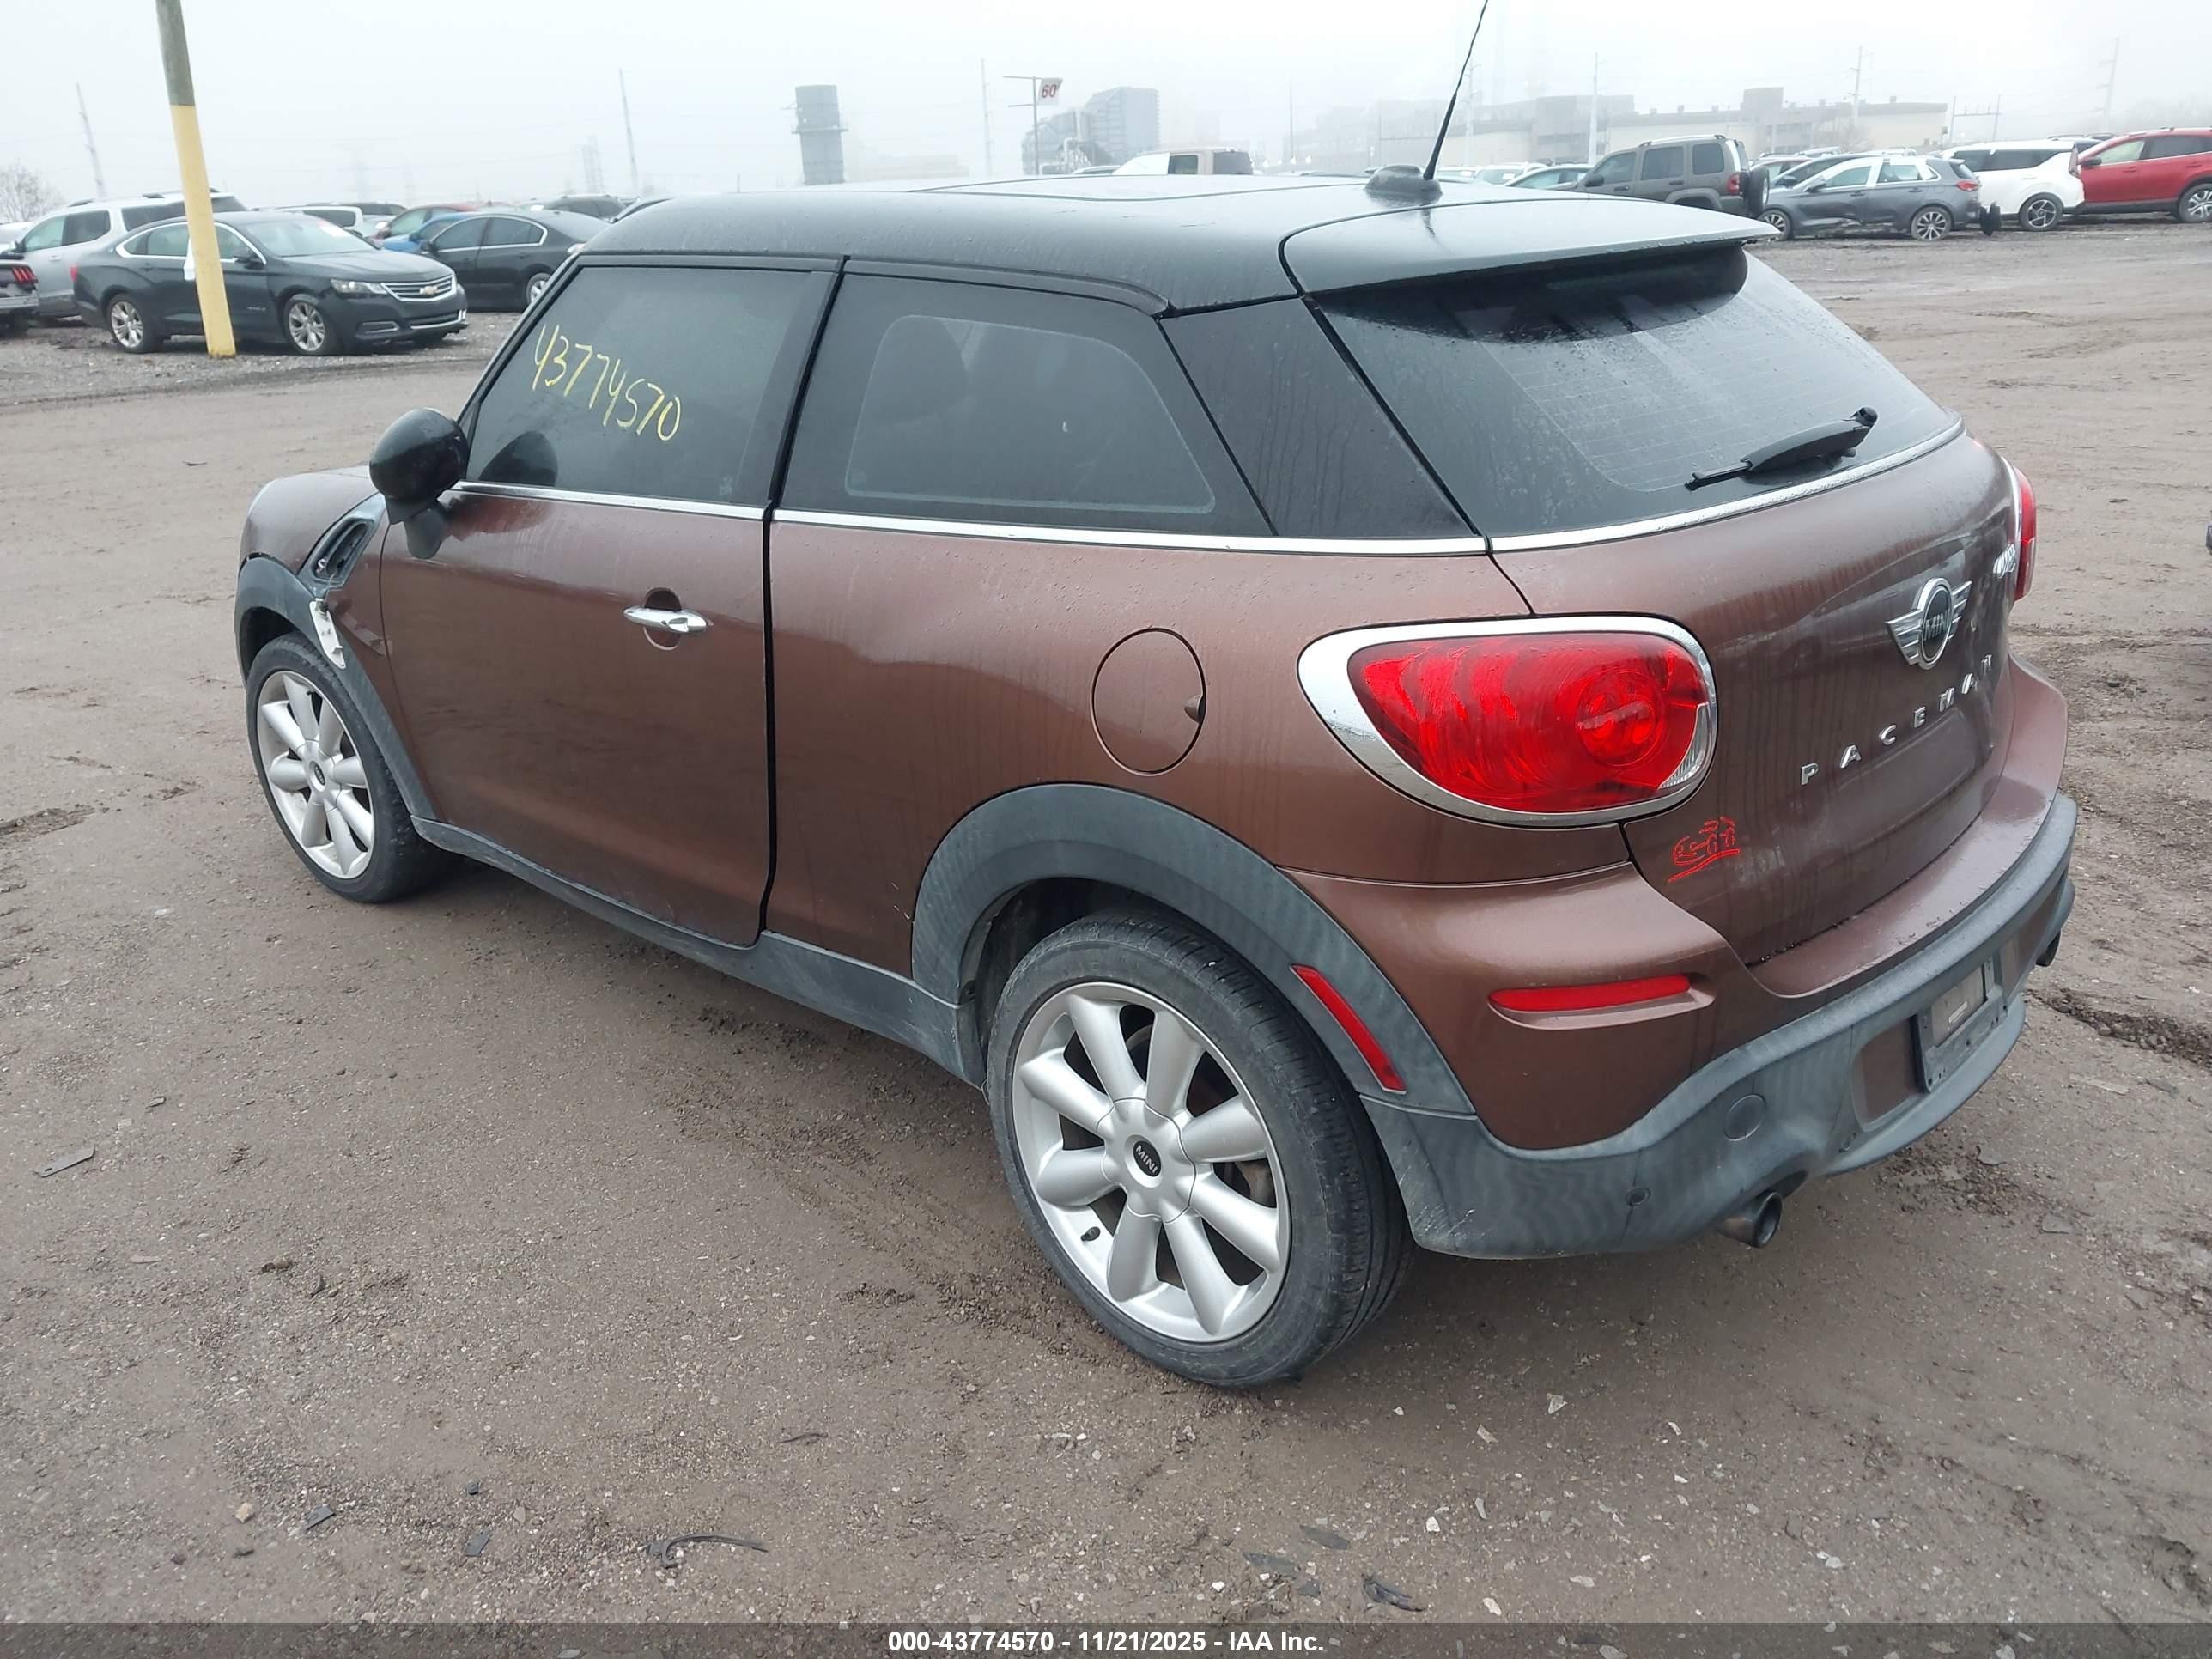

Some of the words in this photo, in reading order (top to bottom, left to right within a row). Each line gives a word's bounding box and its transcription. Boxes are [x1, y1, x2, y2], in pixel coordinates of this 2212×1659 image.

[1042, 83, 1057, 98] 60
[532, 325, 681, 441] 43774570
[1801, 654, 1992, 786] PACEMAN
[1135, 1145, 1158, 1173] MINI
